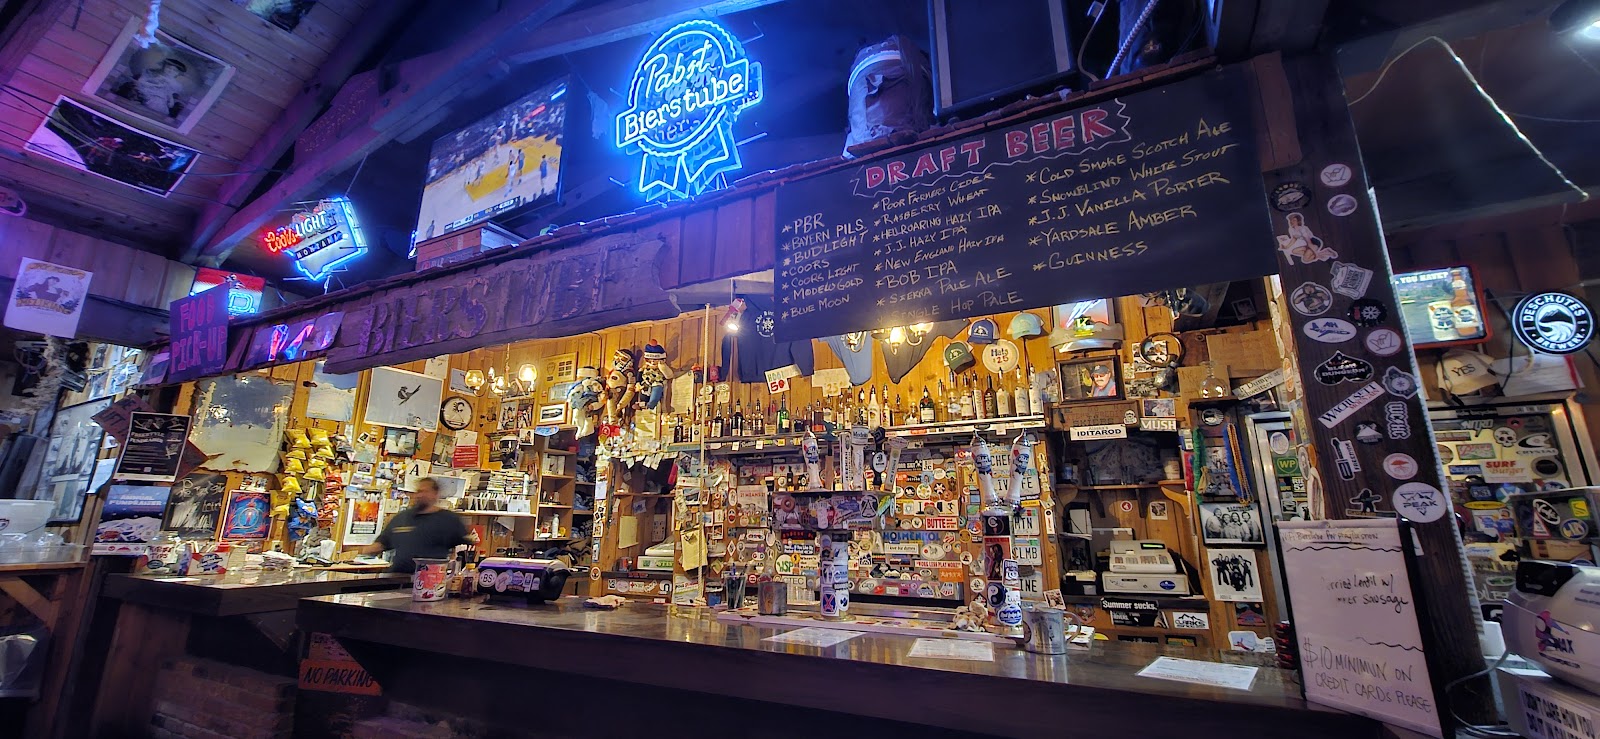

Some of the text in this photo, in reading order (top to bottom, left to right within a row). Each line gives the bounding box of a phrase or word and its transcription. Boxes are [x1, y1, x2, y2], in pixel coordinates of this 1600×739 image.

[643, 40, 712, 99] Pabst
[624, 72, 745, 141] Bierstube
[865, 107, 1117, 189] DRAFT BEER
[1039, 117, 1233, 185] COLD SMOKE SCOTCH ALE
[1038, 143, 1240, 205] SNOWBLIND WHITE STOUT
[881, 196, 906, 212] POOR
[949, 173, 996, 192] CIDER
[1074, 188, 1148, 218] VANILLA
[1147, 171, 1231, 198] PORTER
[882, 188, 989, 225] RASBERRY WHEAT
[945, 210, 973, 225] HAZY
[976, 204, 1003, 219] IPA
[264, 210, 326, 253] Coors LIGHT
[793, 212, 825, 234] PBR
[1041, 204, 1198, 247] YARDSALE AMBER
[792, 229, 830, 250] BAYERN
[909, 231, 937, 248] HAZY
[940, 225, 968, 241] IPA
[884, 234, 1005, 271] NEW ENGLAND HAZY IPA
[1048, 240, 1149, 270] GUINNESS
[789, 258, 830, 276] COORS
[791, 263, 860, 288] COORS LIGHT
[883, 259, 958, 289] BOB IPA
[837, 278, 864, 291] GOLD
[889, 267, 1012, 304] SIERRA PALE ALE
[179, 293, 216, 333] FOOD
[790, 294, 850, 317] BLUE MOON
[890, 290, 1024, 322] SINGLE HOP PALE
[1523, 295, 1587, 322] DESCHUTES
[171, 325, 228, 374] PICK-UP
[991, 348, 1009, 357] Hats
[1536, 333, 1586, 350] BREWERY
[1451, 365, 1476, 376] YES
[1320, 381, 1377, 424] WACHUSETT
[1077, 428, 1122, 437] IDITAROD
[1279, 460, 1296, 468] WP
[1485, 460, 1516, 468] SURF
[1403, 499, 1438, 509] PEAK
[926, 518, 946, 529] BUTTE
[482, 574, 493, 583] BS
[1102, 600, 1158, 611] Summer sucks.
[304, 667, 375, 688] NO PARKING
[1395, 665, 1413, 682] ON
[1315, 672, 1350, 694] CREDIT
[1395, 690, 1432, 713] PLEASE
